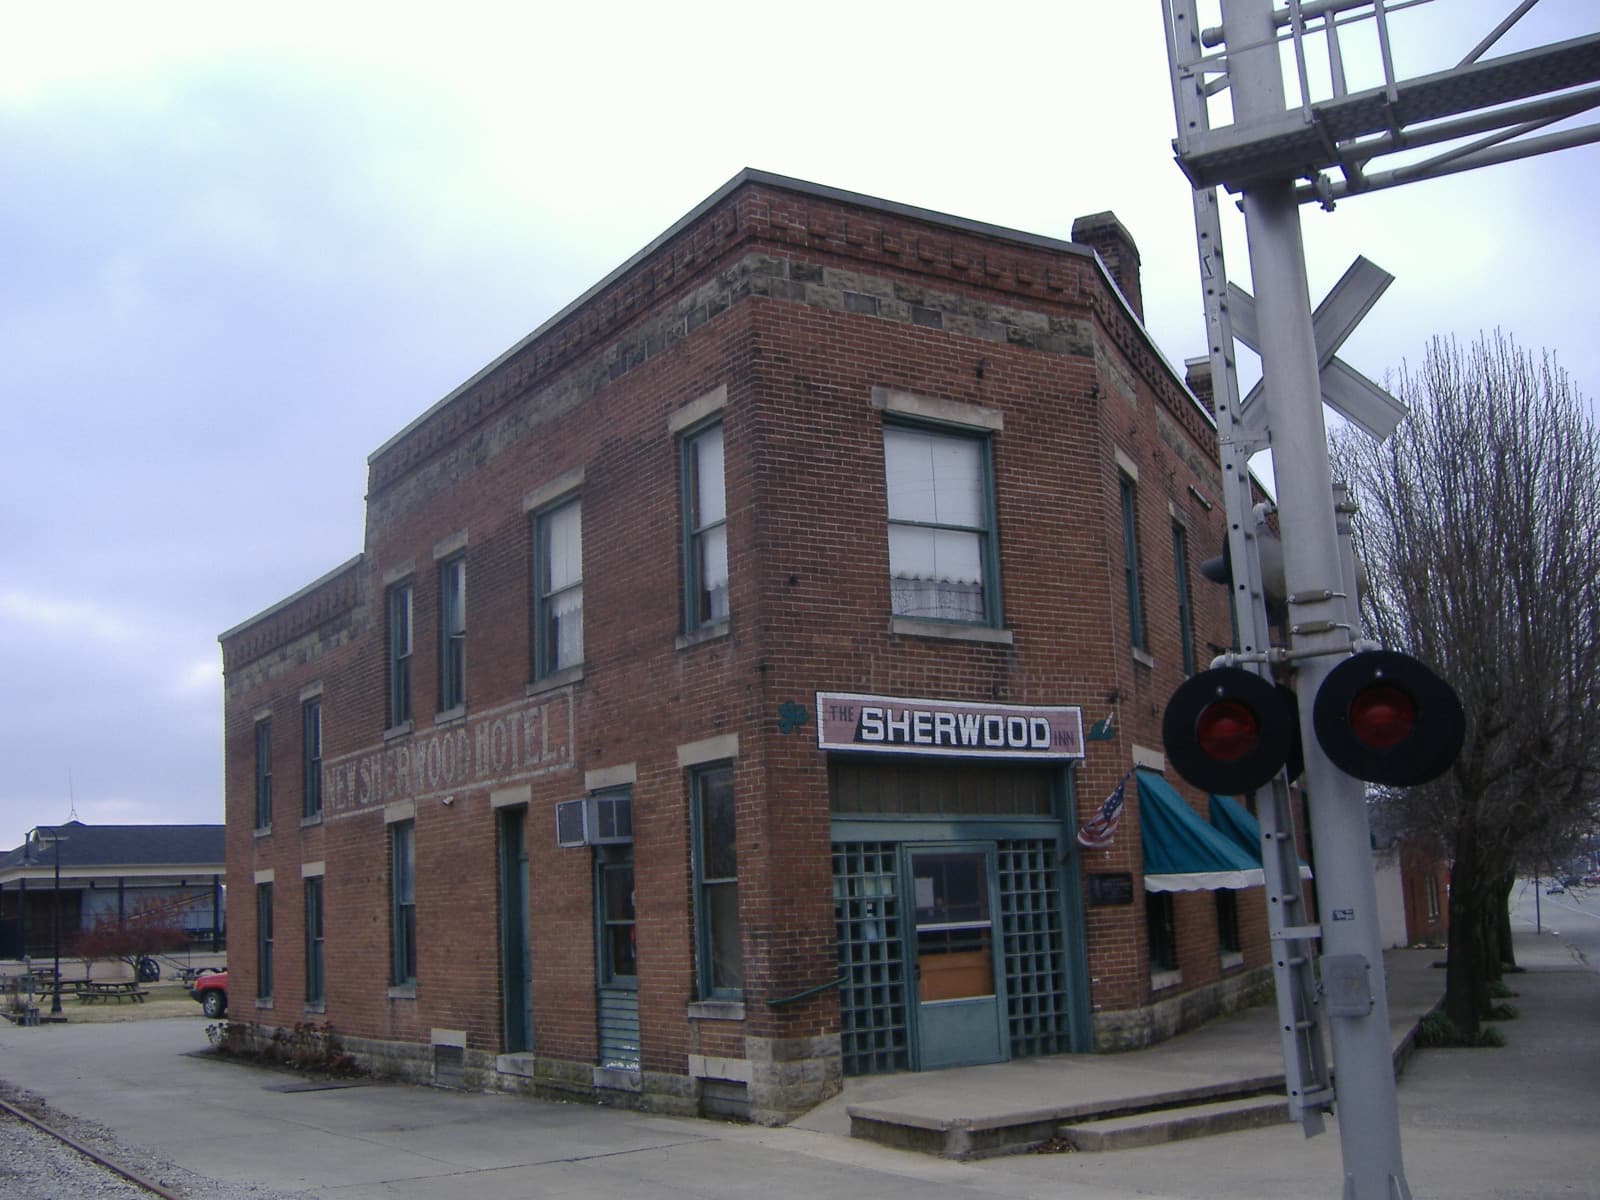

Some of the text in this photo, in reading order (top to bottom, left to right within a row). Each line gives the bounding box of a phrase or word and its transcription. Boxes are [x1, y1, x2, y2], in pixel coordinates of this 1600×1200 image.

[830, 705, 1074, 750] THE SHERWOOD INN
[326, 760, 357, 810] NEW
[359, 727, 471, 805] SHERWOOD
